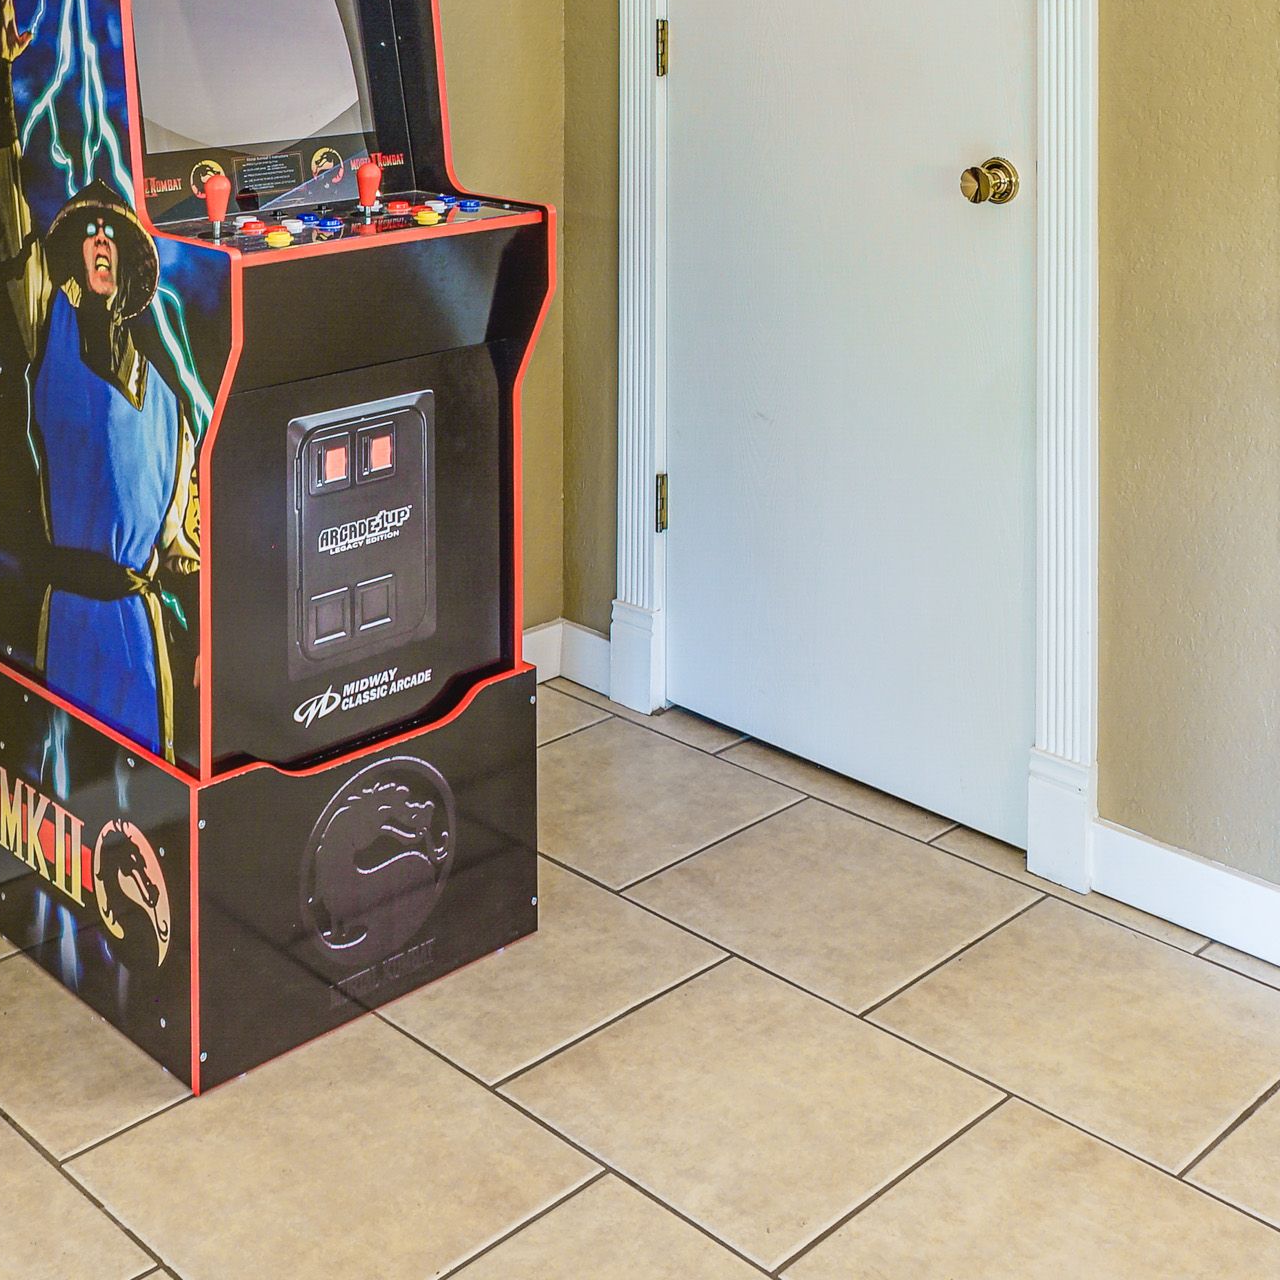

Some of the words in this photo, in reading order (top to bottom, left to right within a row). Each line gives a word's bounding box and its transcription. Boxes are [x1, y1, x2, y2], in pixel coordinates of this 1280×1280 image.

[150, 177, 182, 194] KOMBAT
[329, 540, 365, 555] LEGACY
[365, 529, 400, 545] EDITION
[341, 685, 388, 711] CLASSIC
[389, 668, 432, 695] ARCADE
[342, 667, 398, 697] MIDWAY
